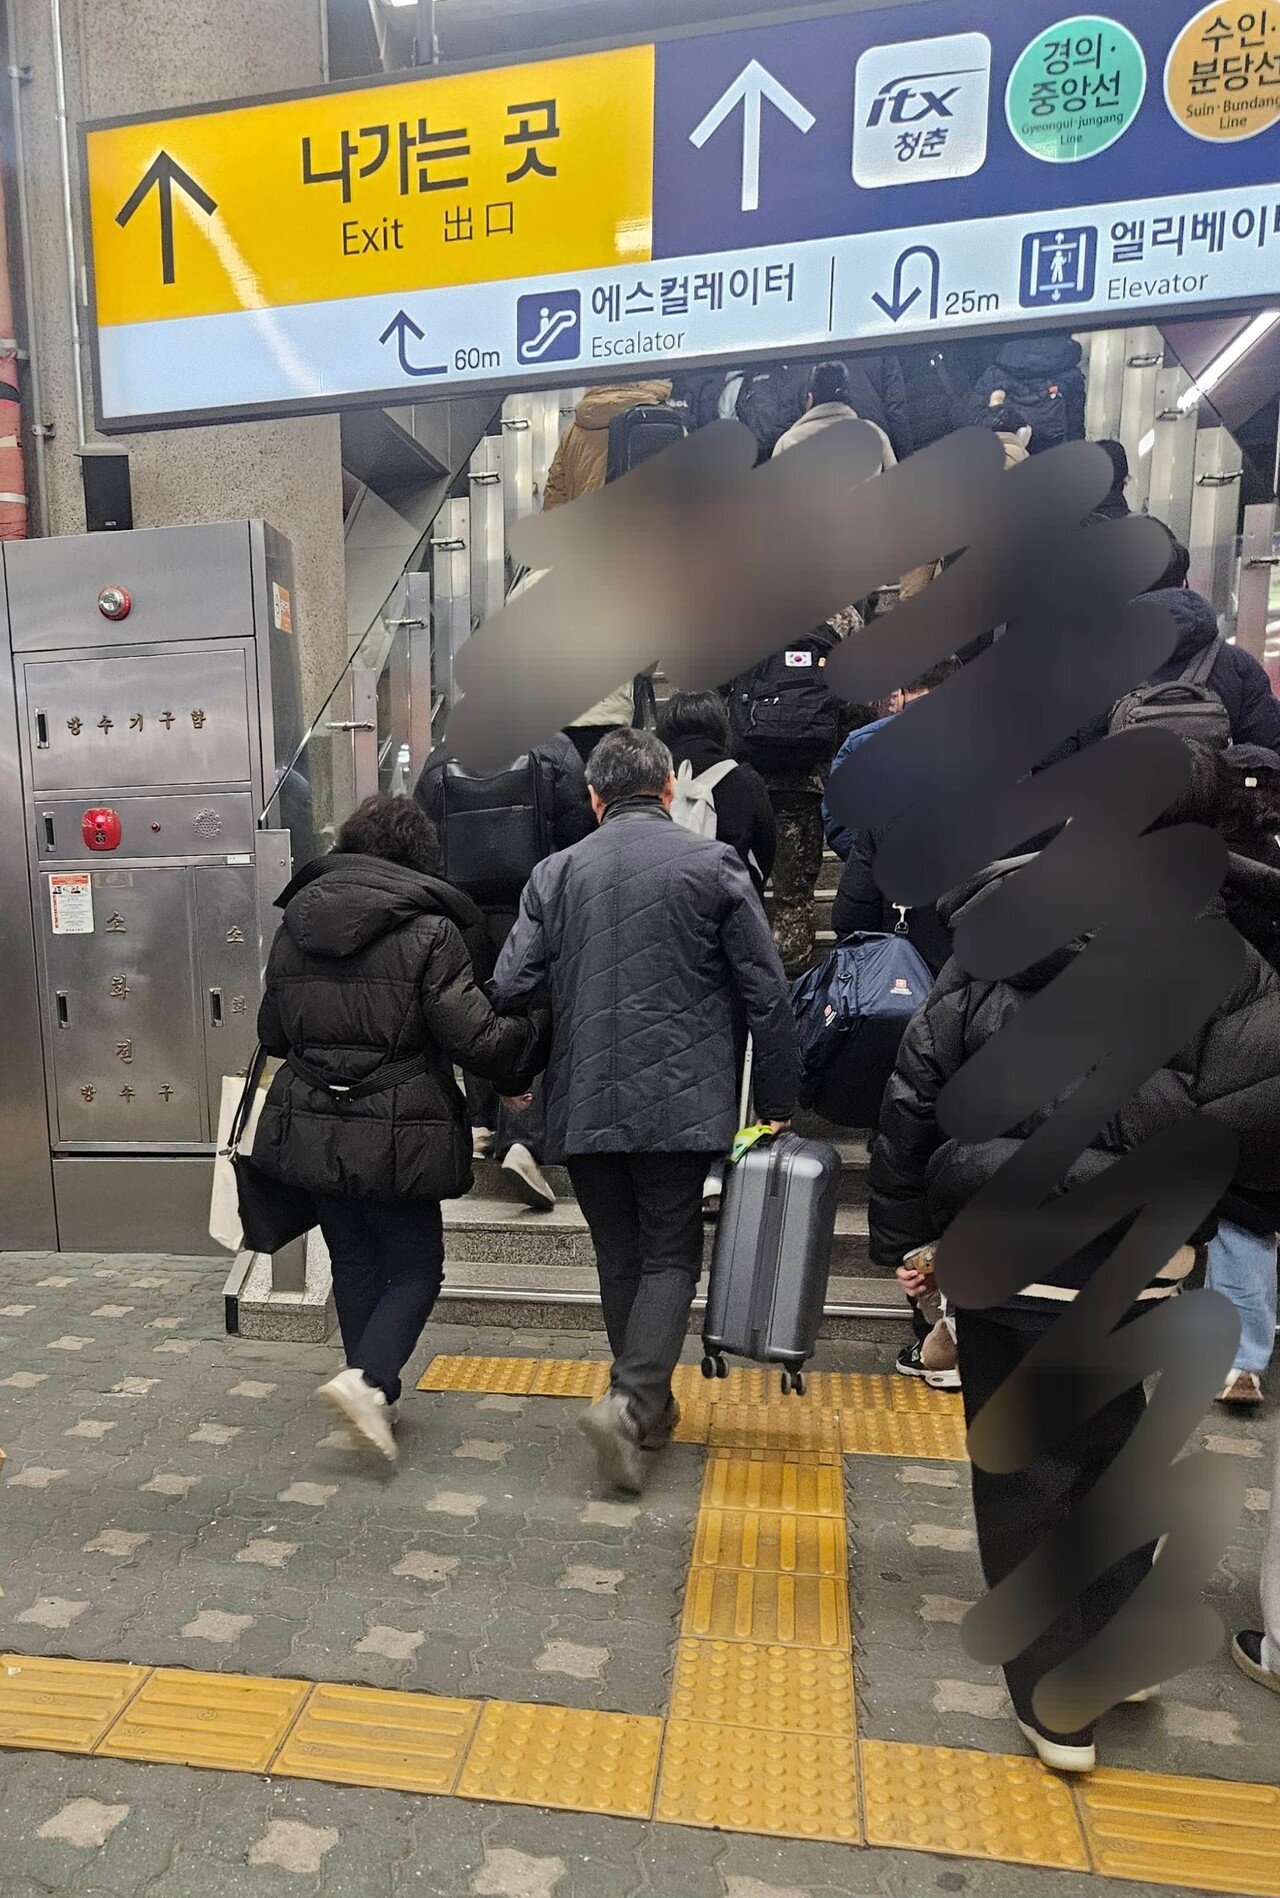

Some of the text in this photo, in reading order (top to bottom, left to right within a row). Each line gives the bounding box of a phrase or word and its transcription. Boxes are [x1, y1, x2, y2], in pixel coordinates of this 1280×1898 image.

[1029, 70, 1121, 116] 중앙선
[1219, 117, 1247, 129] Line
[302, 98, 560, 203] 나가는 곳
[894, 128, 949, 162] 청춘
[1060, 134, 1083, 145] Line
[444, 201, 514, 243] 出口
[1110, 205, 1280, 264] 엘리베이
[343, 217, 404, 256] Exit
[592, 263, 795, 322] 에스컬레이터
[1107, 273, 1209, 301] Elevator
[945, 290, 999, 316] 25m
[592, 330, 686, 358] Escalator
[454, 347, 501, 371] 60m
[66, 709, 206, 736] 방수기구함
[80, 1083, 174, 1103] 방수구
